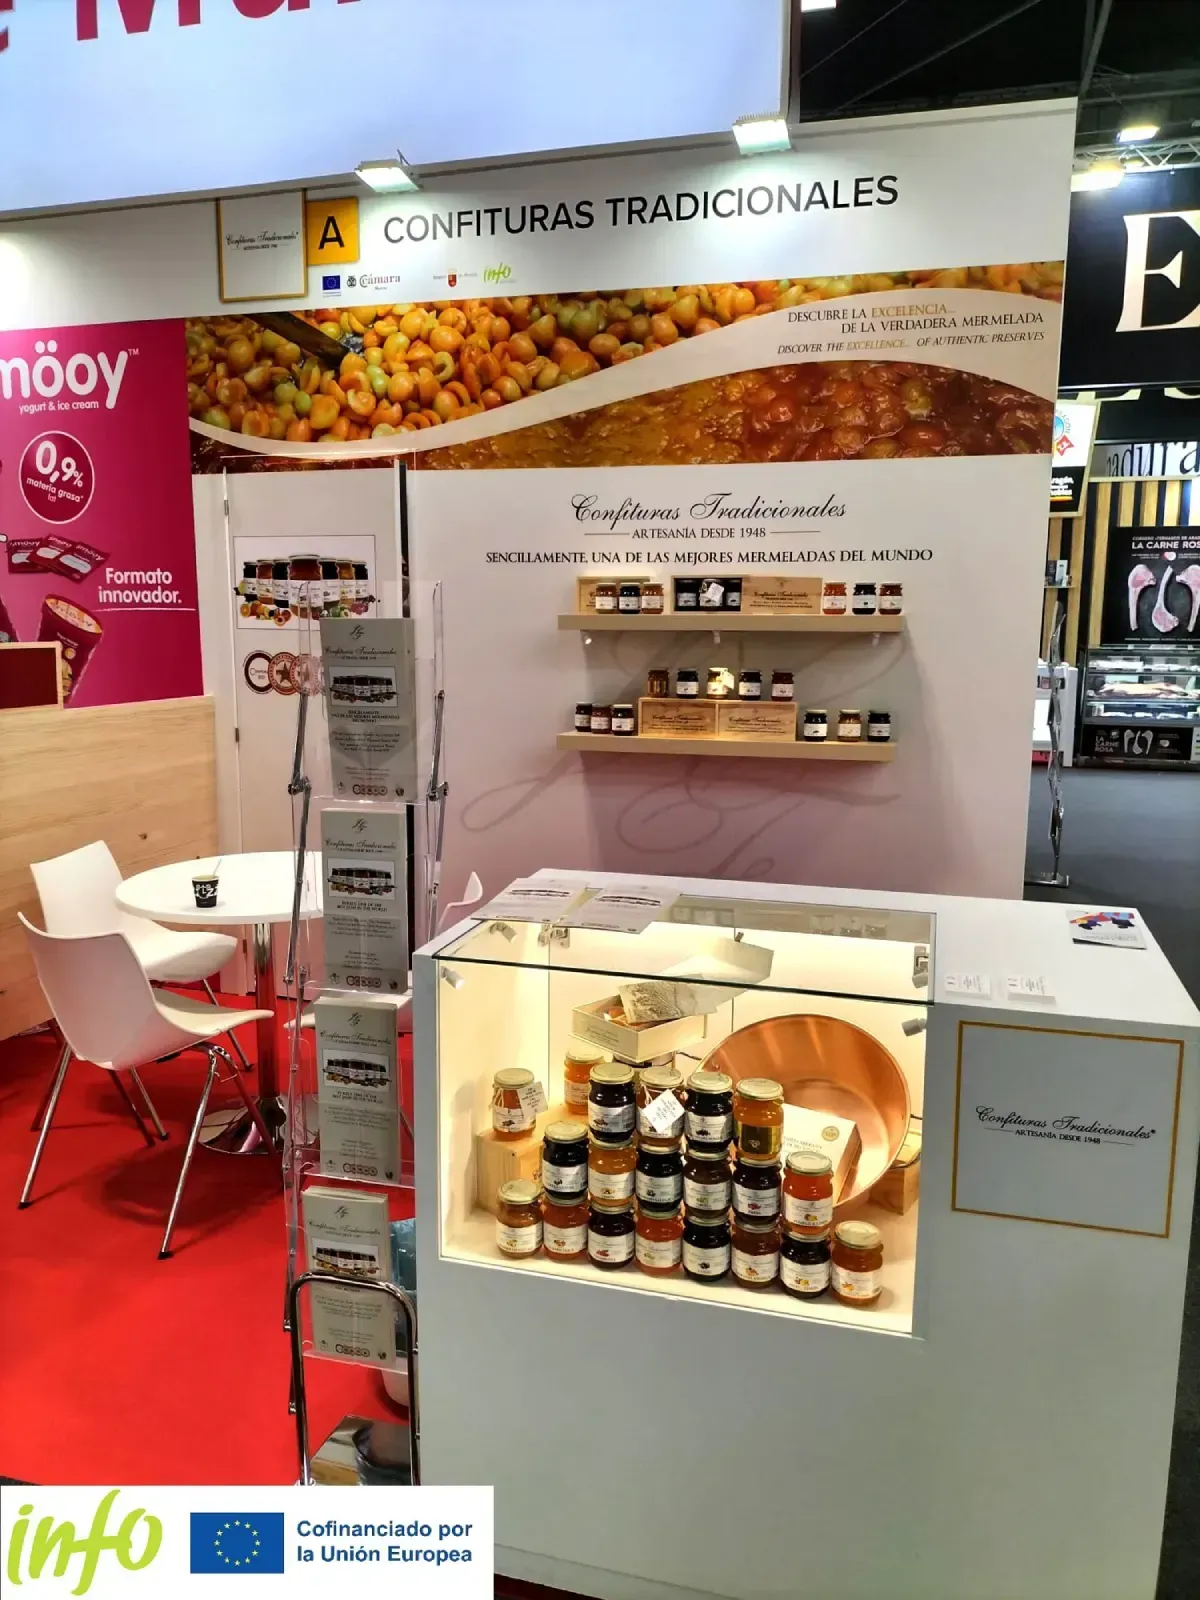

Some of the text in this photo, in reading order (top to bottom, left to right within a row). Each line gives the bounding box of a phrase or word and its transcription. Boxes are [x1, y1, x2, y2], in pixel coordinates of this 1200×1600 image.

[383, 175, 899, 244] CONFITURAS TRADICIONALES
[318, 215, 345, 250] A
[788, 308, 849, 323] DESCUBRE
[852, 307, 867, 319] LA
[841, 312, 1044, 334] DE LA VERDADERA MERMELADA
[777, 342, 823, 354] DISCOVER
[826, 341, 845, 352] THE
[916, 337, 931, 347] OF
[932, 333, 991, 347] AUTHENTIC
[991, 331, 1045, 343] PRESERVES
[19, 400, 100, 415] yogurt & ice cream
[35, 440, 84, 488] 0,9%
[1106, 441, 1200, 477] adura
[26, 476, 57, 494] materia
[570, 491, 847, 530] Confituras Tradicionales
[631, 527, 767, 540] ARTESANÍA DESDE 1948
[1131, 541, 1144, 549] LA
[1146, 541, 1179, 549] CARNE
[485, 548, 934, 566] SENCILLAMENTE, UNA DE LAS MEJORES MERMELADAS DEL MUNDO
[105, 567, 173, 585] Formato
[98, 586, 182, 604] innovador.
[975, 1105, 1048, 1129] Confituras
[1014, 1128, 1101, 1145] ARTESANÍA DESDE 1948
